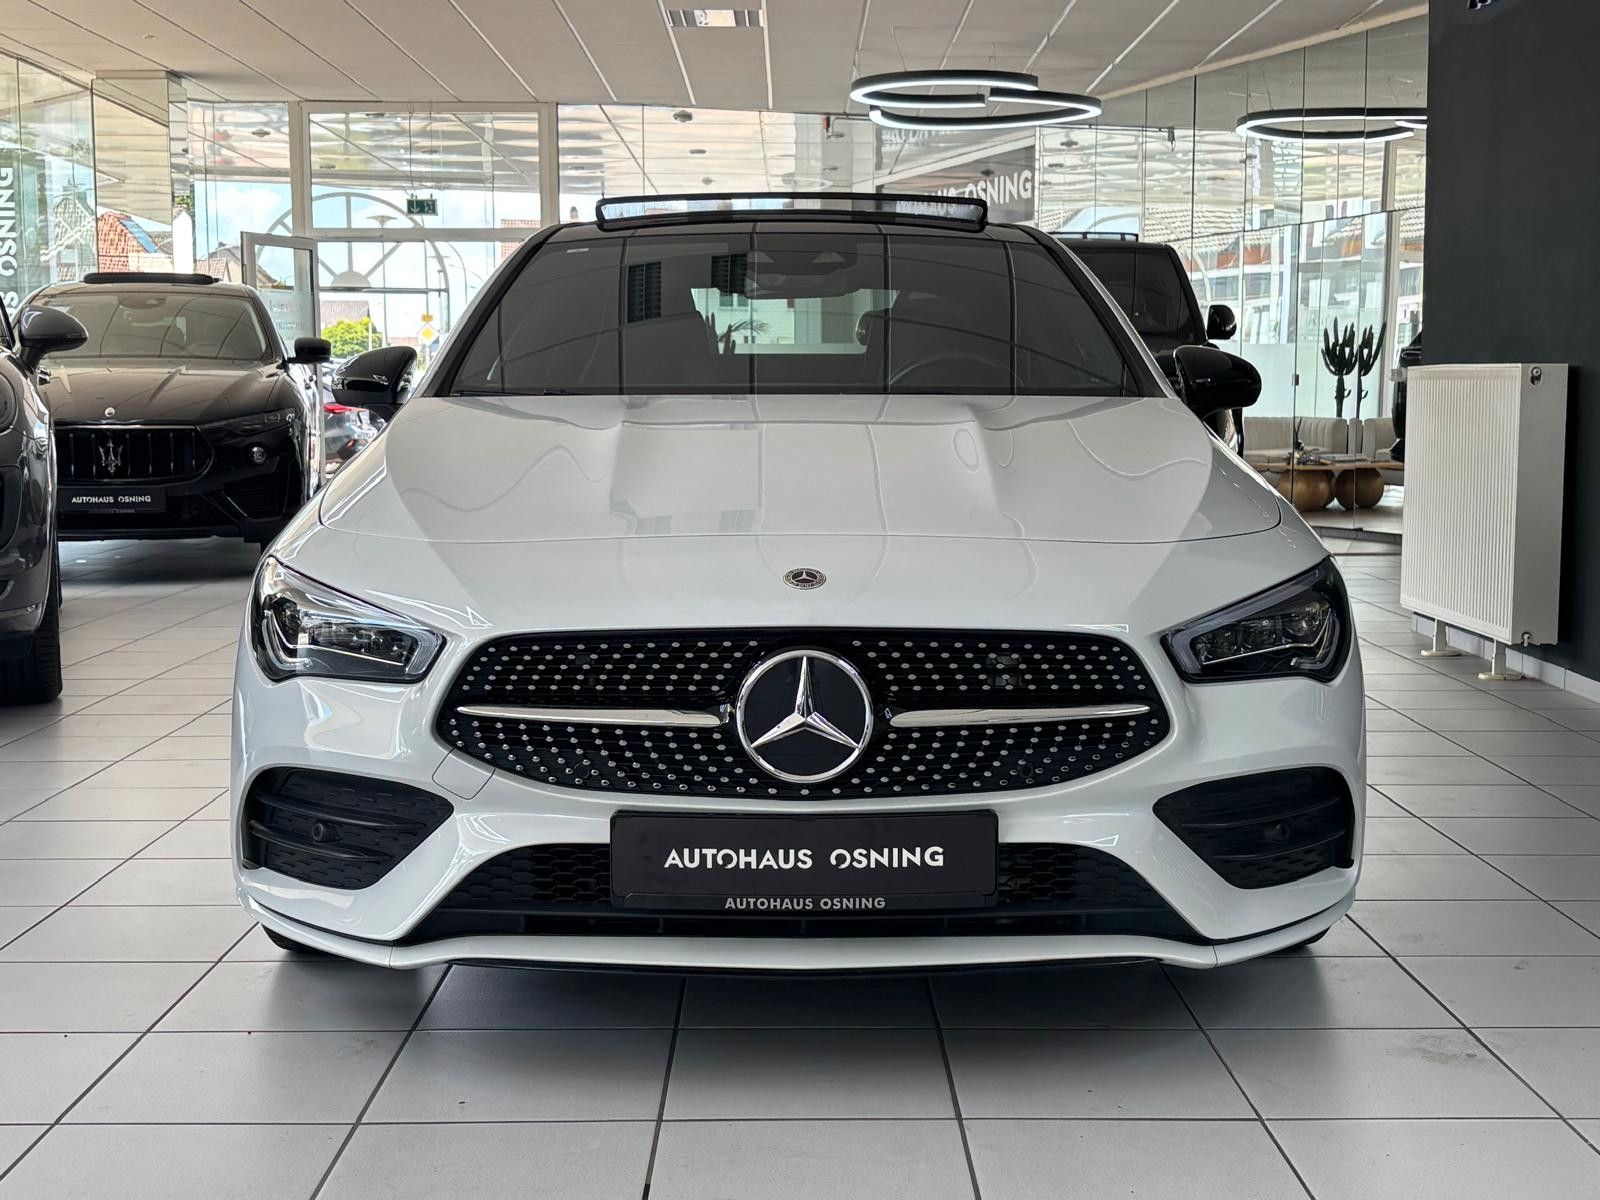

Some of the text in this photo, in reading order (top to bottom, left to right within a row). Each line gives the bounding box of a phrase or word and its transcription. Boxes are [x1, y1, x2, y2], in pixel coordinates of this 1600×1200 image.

[71, 495, 152, 504] AUTOHAUS OSNING
[664, 846, 944, 870] AUTOHAUS OSNING
[725, 896, 886, 911] AUTOHAUS OSNING
